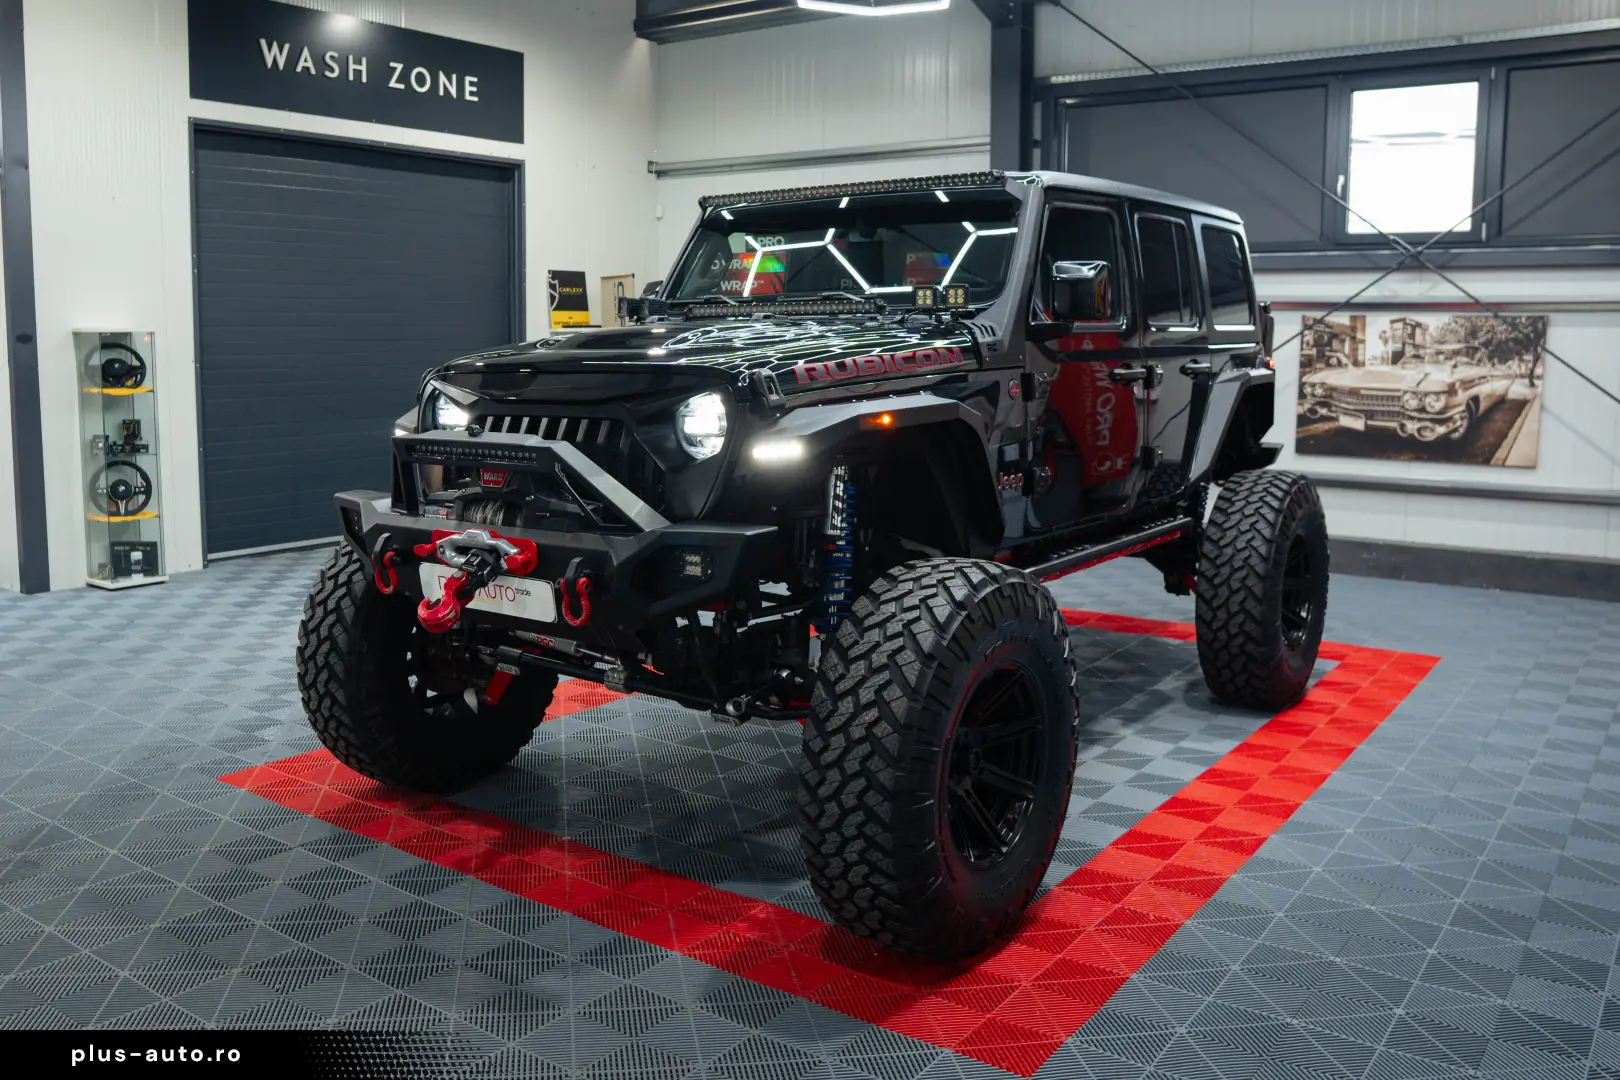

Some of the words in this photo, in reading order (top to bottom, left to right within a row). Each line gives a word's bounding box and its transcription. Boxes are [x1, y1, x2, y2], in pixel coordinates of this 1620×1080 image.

[259, 38, 367, 83] WASH
[388, 61, 479, 102] ZONE
[793, 347, 965, 385] RUBICON
[483, 472, 504, 481] WARN
[998, 472, 1024, 489] Jeep
